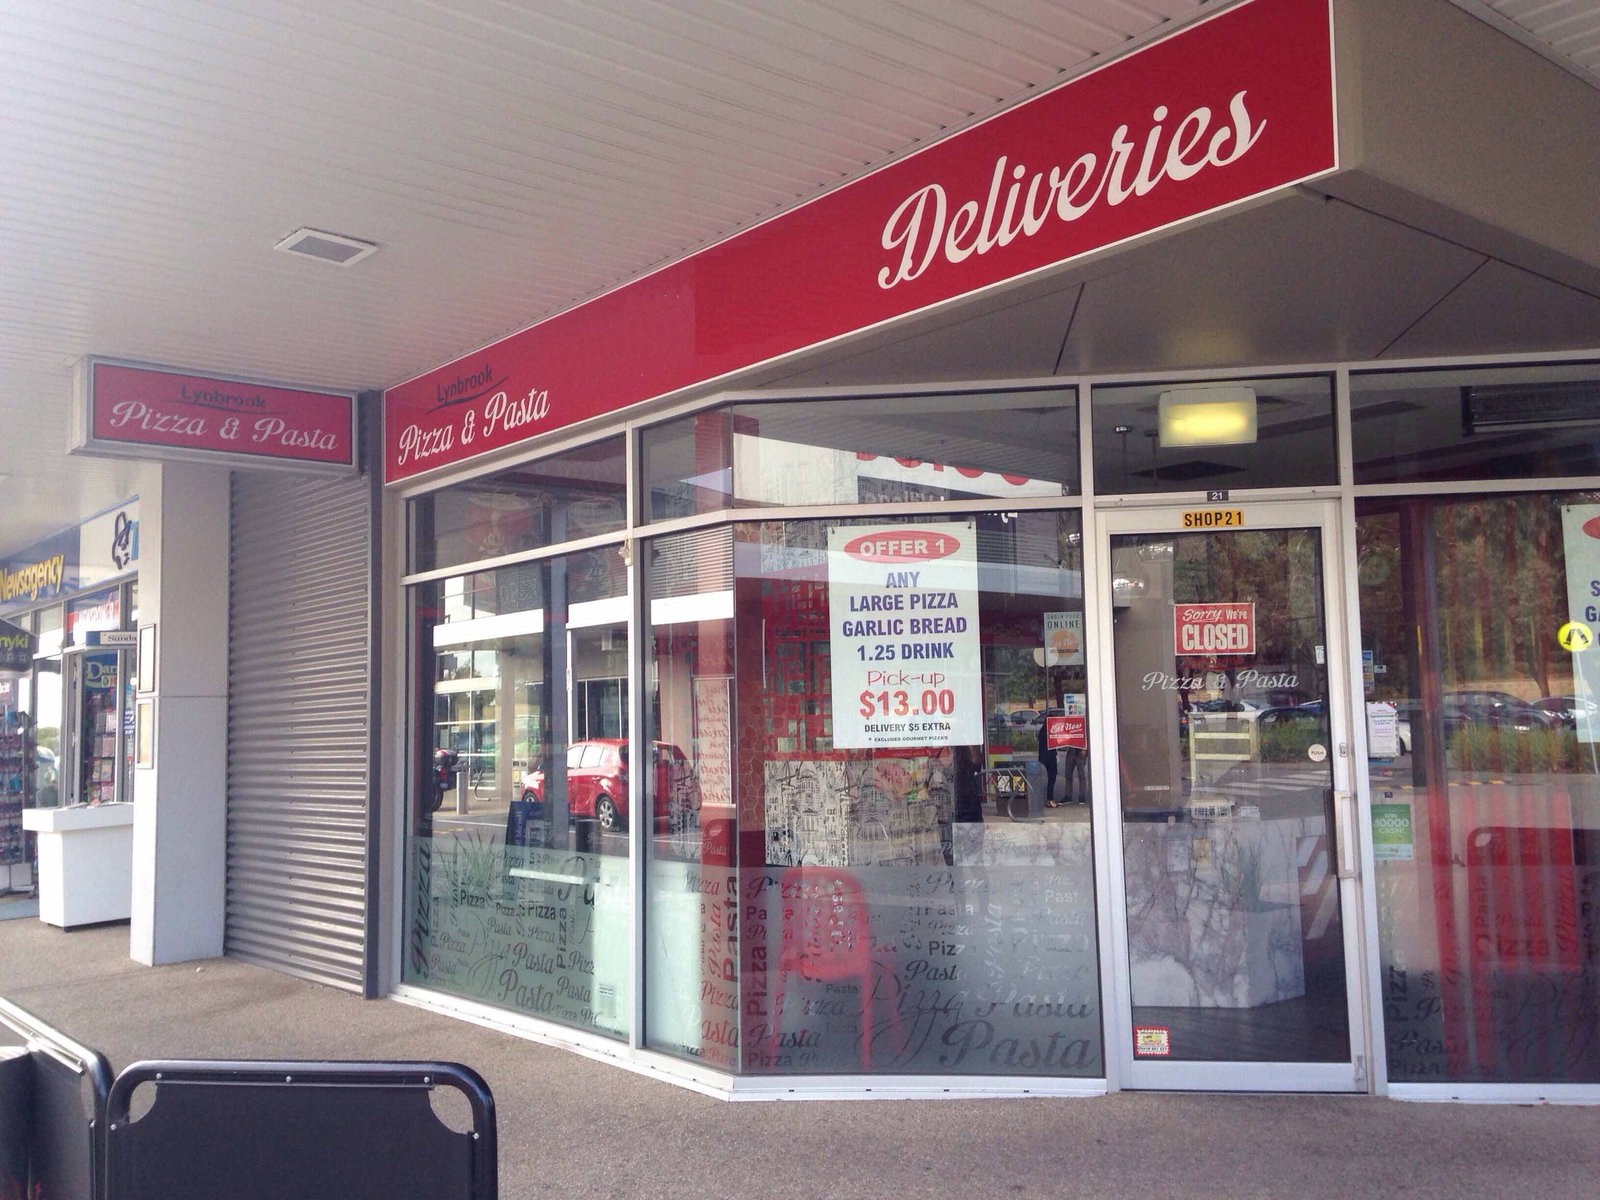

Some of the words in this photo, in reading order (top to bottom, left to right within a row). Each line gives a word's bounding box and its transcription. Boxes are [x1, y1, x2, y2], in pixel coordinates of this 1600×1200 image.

[877, 90, 1267, 289] Deliveries
[436, 364, 493, 402] Lynbrook
[181, 384, 266, 408] Lynbrook
[110, 401, 208, 436] Pizza
[219, 417, 240, 440] &
[252, 418, 338, 450] Pasta
[398, 424, 454, 465] Pizza
[461, 410, 475, 445] &
[483, 388, 550, 437] Pasta
[1211, 491, 1223, 500] 21
[860, 539, 929, 557] OFFER
[935, 538, 945, 554] 1
[0, 554, 64, 600] Newsagency
[886, 571, 920, 589] ANY
[850, 594, 904, 612] LARGE
[910, 592, 959, 610] PIZZA
[842, 618, 904, 637] GARLIC
[910, 616, 967, 635] BREAD
[1047, 620, 1080, 629] ONLINE
[1182, 608, 1222, 623] Sorry
[1225, 609, 1248, 620] We're
[1181, 623, 1249, 651] CLOSED
[857, 643, 896, 661] 1.25
[901, 641, 954, 660] DRINK
[867, 670, 946, 688] Pick-up
[1141, 670, 1205, 690] Pizza
[1235, 669, 1300, 689] Pasta
[859, 689, 955, 720] $13.00
[864, 723, 906, 733] DELIVERY
[908, 722, 920, 732] $5
[922, 722, 951, 731] EXTRA
[460, 889, 486, 909] Pizza
[527, 901, 556, 920] Pizza
[512, 942, 555, 975] Pasta
[928, 940, 966, 956] Pizz
[568, 950, 595, 976] Pizz
[903, 960, 960, 982] Past
[497, 968, 554, 1013] Pasta
[557, 976, 592, 1003] Pasta
[747, 946, 767, 1016] Pizza
[701, 1020, 738, 1049] asta
[938, 1019, 1097, 1070] Pasta
